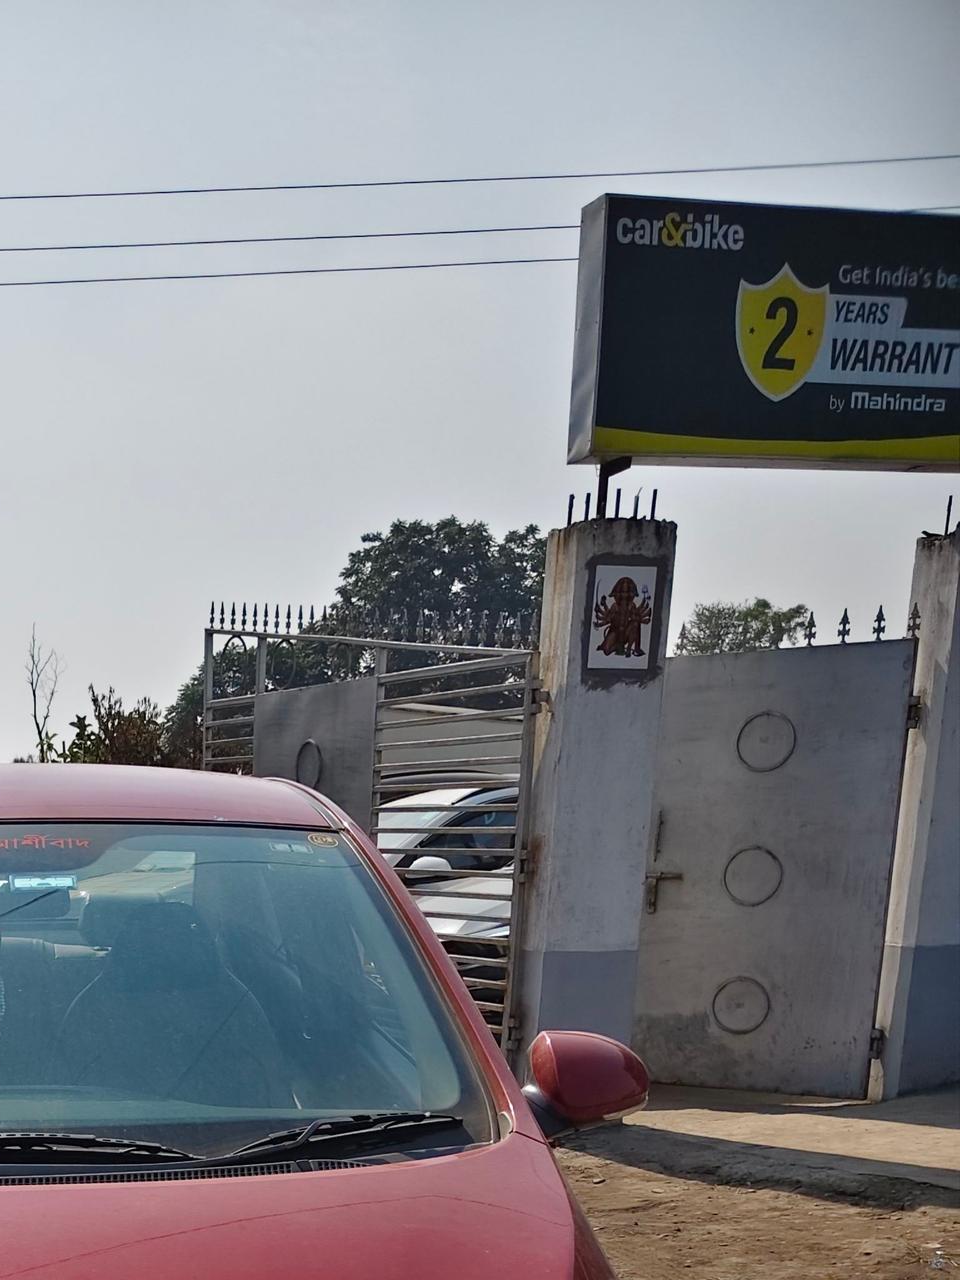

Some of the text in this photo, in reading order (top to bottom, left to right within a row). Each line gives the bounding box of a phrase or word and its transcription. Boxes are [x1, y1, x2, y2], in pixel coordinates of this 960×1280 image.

[616, 212, 744, 251] car&bike
[839, 264, 871, 284] Get
[875, 266, 932, 288] India's
[834, 300, 890, 324] YEARS
[762, 297, 799, 371] 2
[830, 337, 960, 375] WARRANT
[829, 391, 946, 413] by Mahindra
